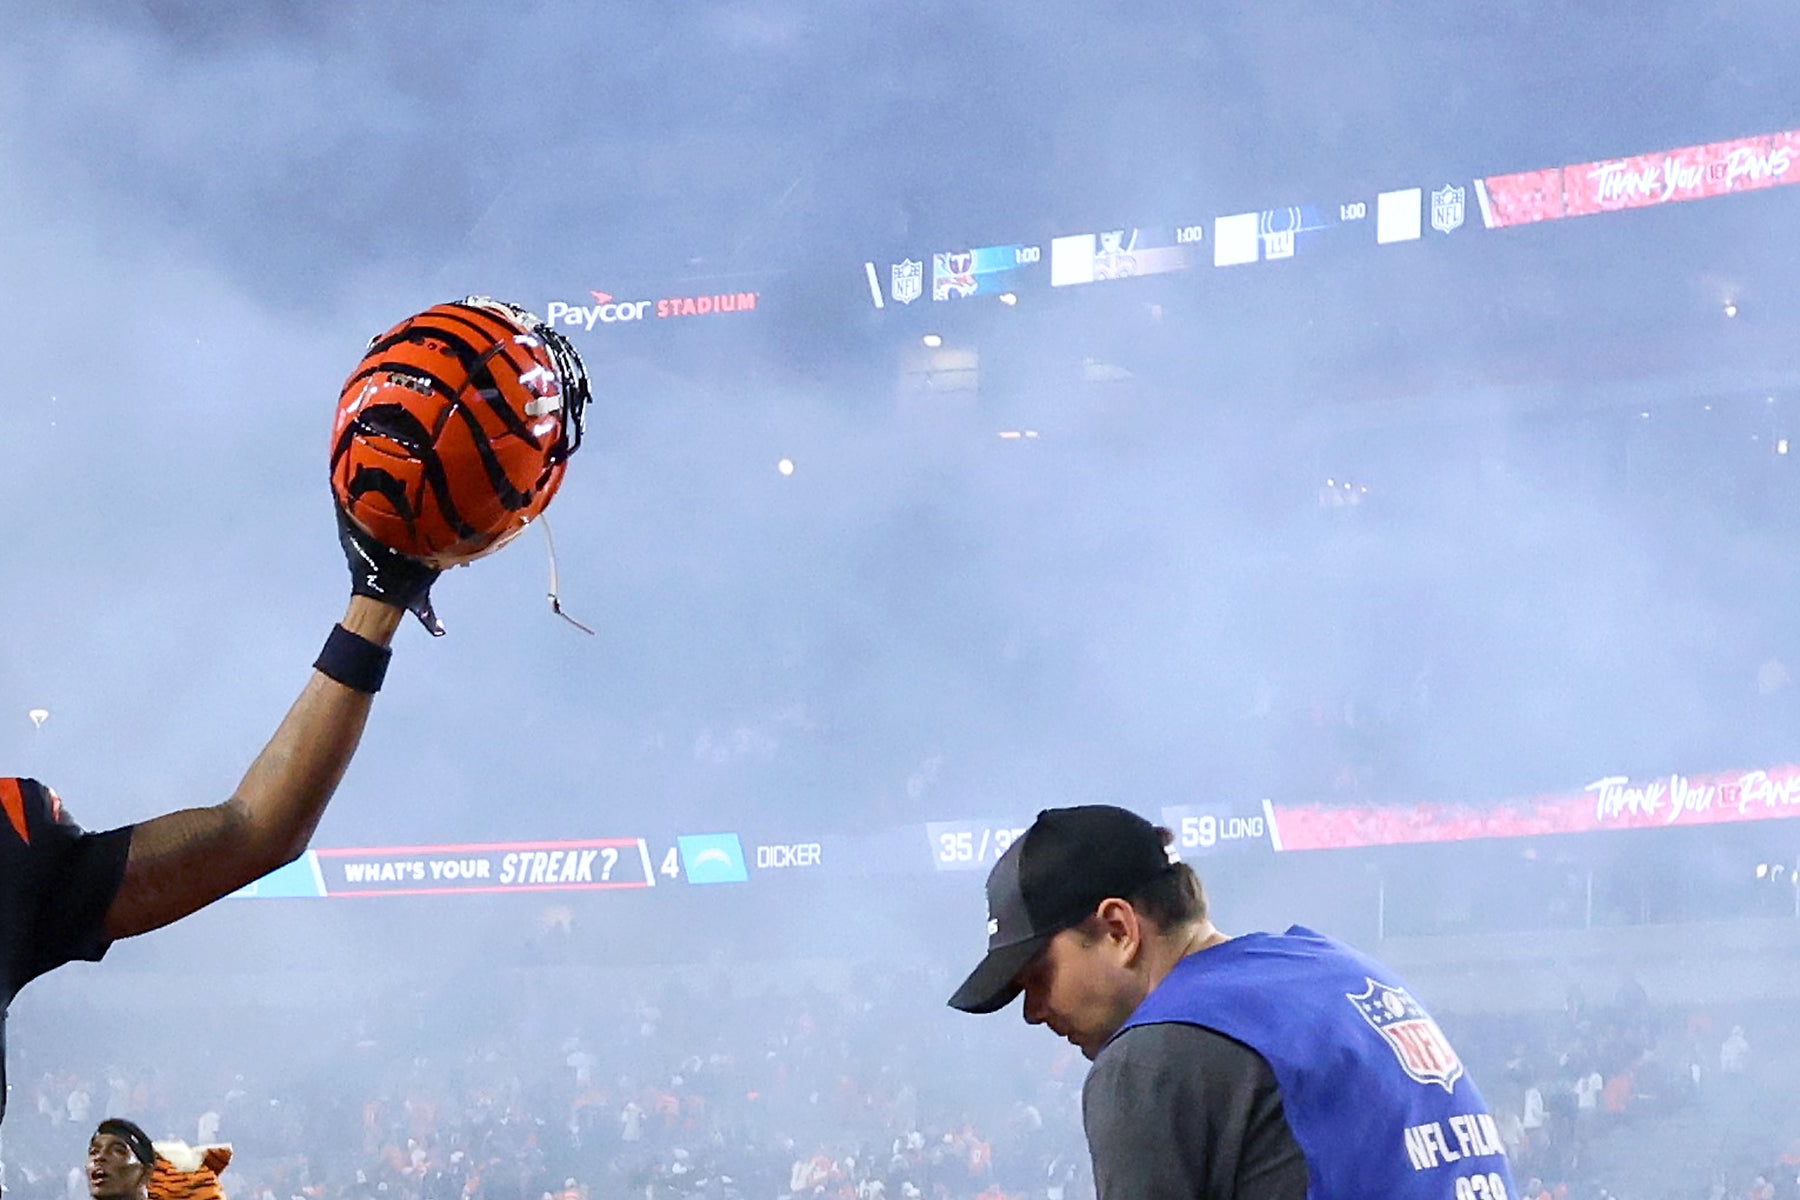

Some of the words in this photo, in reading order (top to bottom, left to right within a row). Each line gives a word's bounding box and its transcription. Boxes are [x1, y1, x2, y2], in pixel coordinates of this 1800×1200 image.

[547, 300, 652, 331] Paycor
[656, 292, 758, 318] STADIUM
[939, 832, 973, 863] 35
[995, 828, 1027, 858] 3
[1181, 815, 1217, 848] 59
[1220, 817, 1264, 841] LONG
[344, 862, 425, 882] WHAT'S
[429, 860, 490, 880] YOUR
[661, 847, 679, 879] 4
[757, 843, 821, 868] DICKER
[1384, 1020, 1457, 1073] NFL
[1404, 1121, 1461, 1171] NFL
